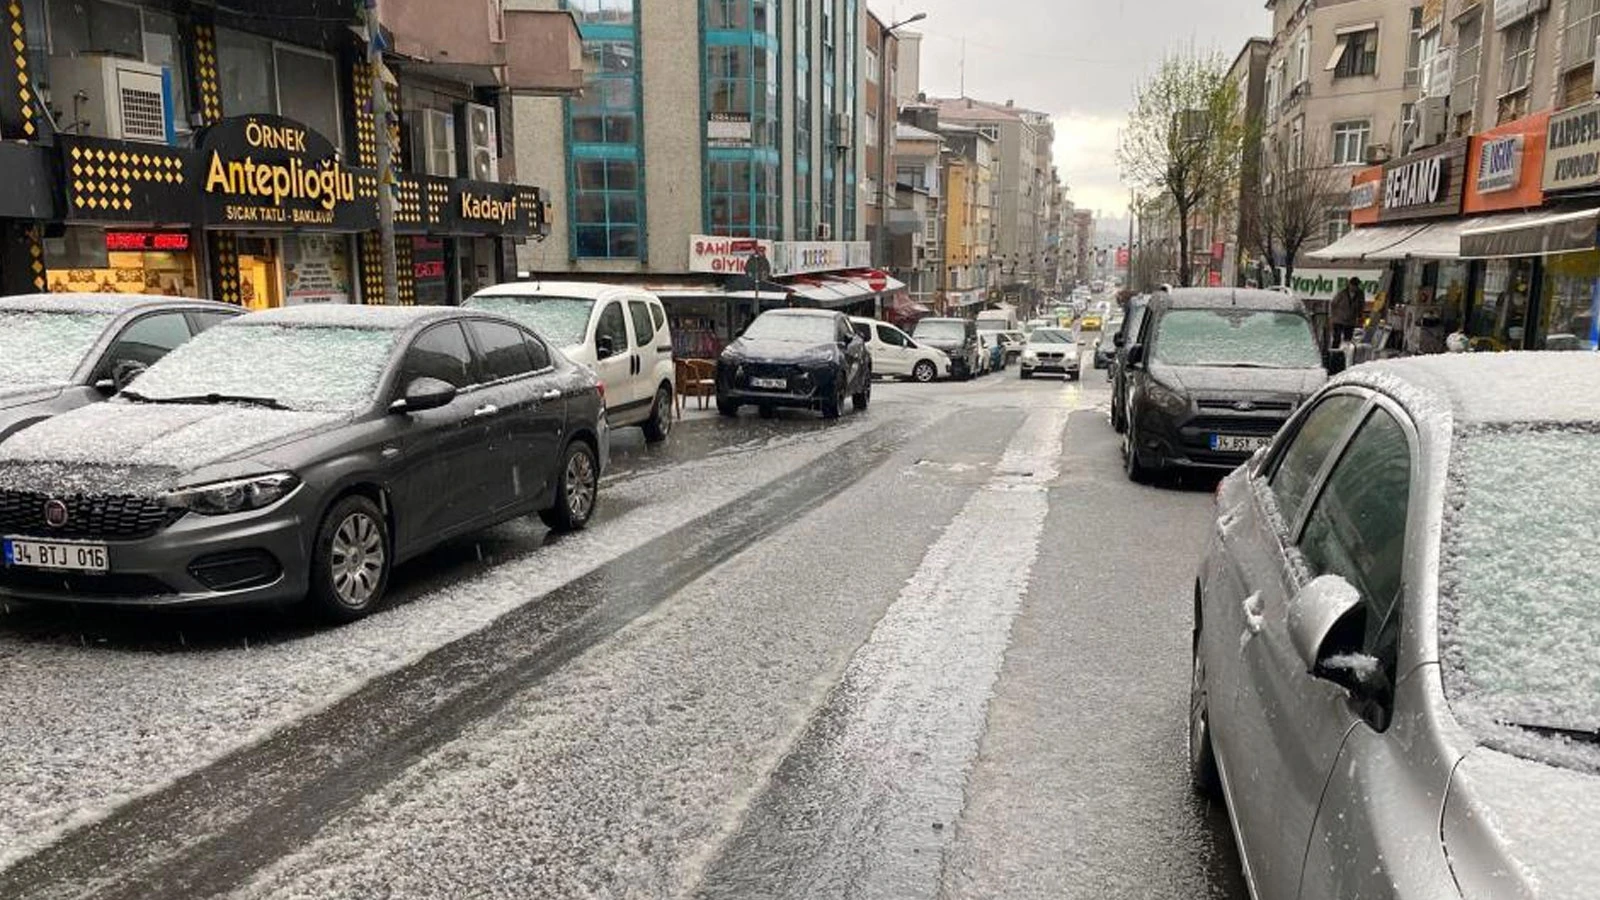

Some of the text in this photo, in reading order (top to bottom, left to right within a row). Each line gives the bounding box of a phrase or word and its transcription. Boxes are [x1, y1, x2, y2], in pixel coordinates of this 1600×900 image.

[246, 118, 306, 152] ÖRNEK
[205, 150, 355, 210] Anteplioğlu
[1385, 154, 1441, 209] BEHAMO
[226, 205, 258, 221] SICAK
[260, 207, 286, 222] TATLI
[461, 191, 517, 227] Kadayıf
[1293, 274, 1333, 296] Yayla
[13, 542, 104, 567] 34 BTJ 016
